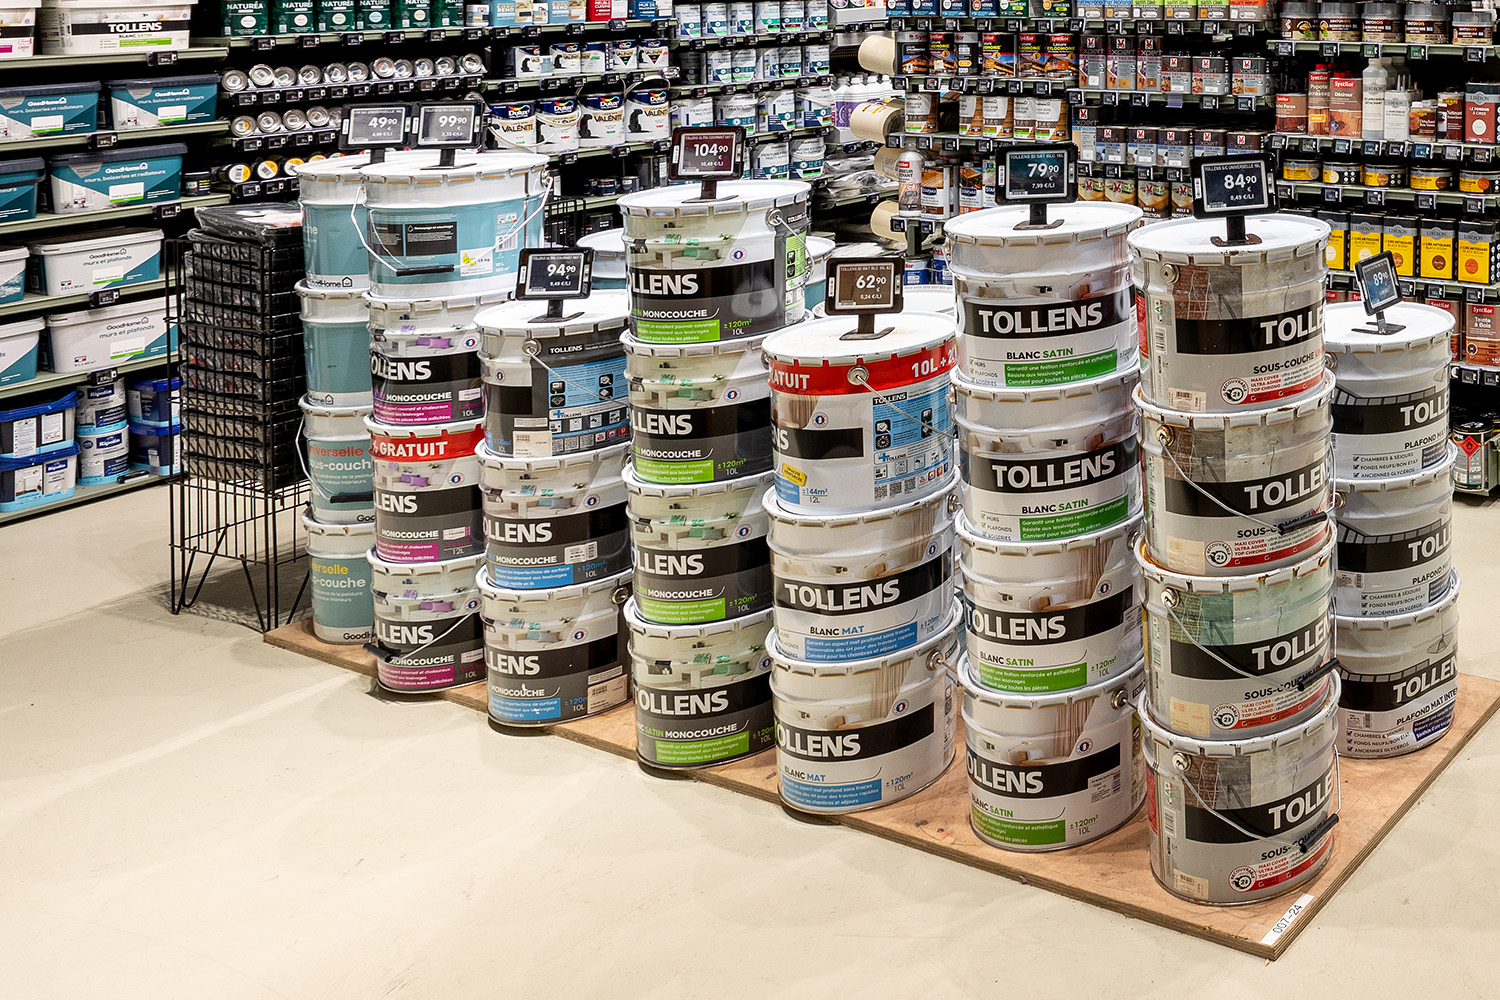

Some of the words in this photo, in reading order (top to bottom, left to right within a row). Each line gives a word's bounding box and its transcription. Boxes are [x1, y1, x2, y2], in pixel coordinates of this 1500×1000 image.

[108, 22, 163, 33] TOLLENS
[642, 309, 708, 318] MONOCOUCHE
[979, 302, 1102, 334] TOLLENS
[1260, 304, 1324, 345] TOLLE
[550, 344, 583, 354] TOLLENS
[1006, 351, 1041, 360] BLANC
[1043, 347, 1074, 358] SATIN
[912, 360, 937, 377] 10L
[1253, 352, 1315, 374] SOUS-COUCHE
[386, 392, 452, 402] MONOCOUCHE
[631, 414, 692, 436] LLENS
[380, 441, 448, 458] GRATUIT
[640, 449, 702, 459] MONOCOUCHE
[992, 450, 1116, 488] TOLLENS
[1021, 504, 1056, 514] BLANC
[1058, 498, 1089, 511] SATIN
[784, 579, 899, 611] TOLLENS
[810, 626, 840, 636] BLANC
[842, 625, 865, 635] MAT
[1005, 657, 1034, 667] SATIN
[806, 773, 826, 783] MAT
[1272, 903, 1303, 934] 007-24
